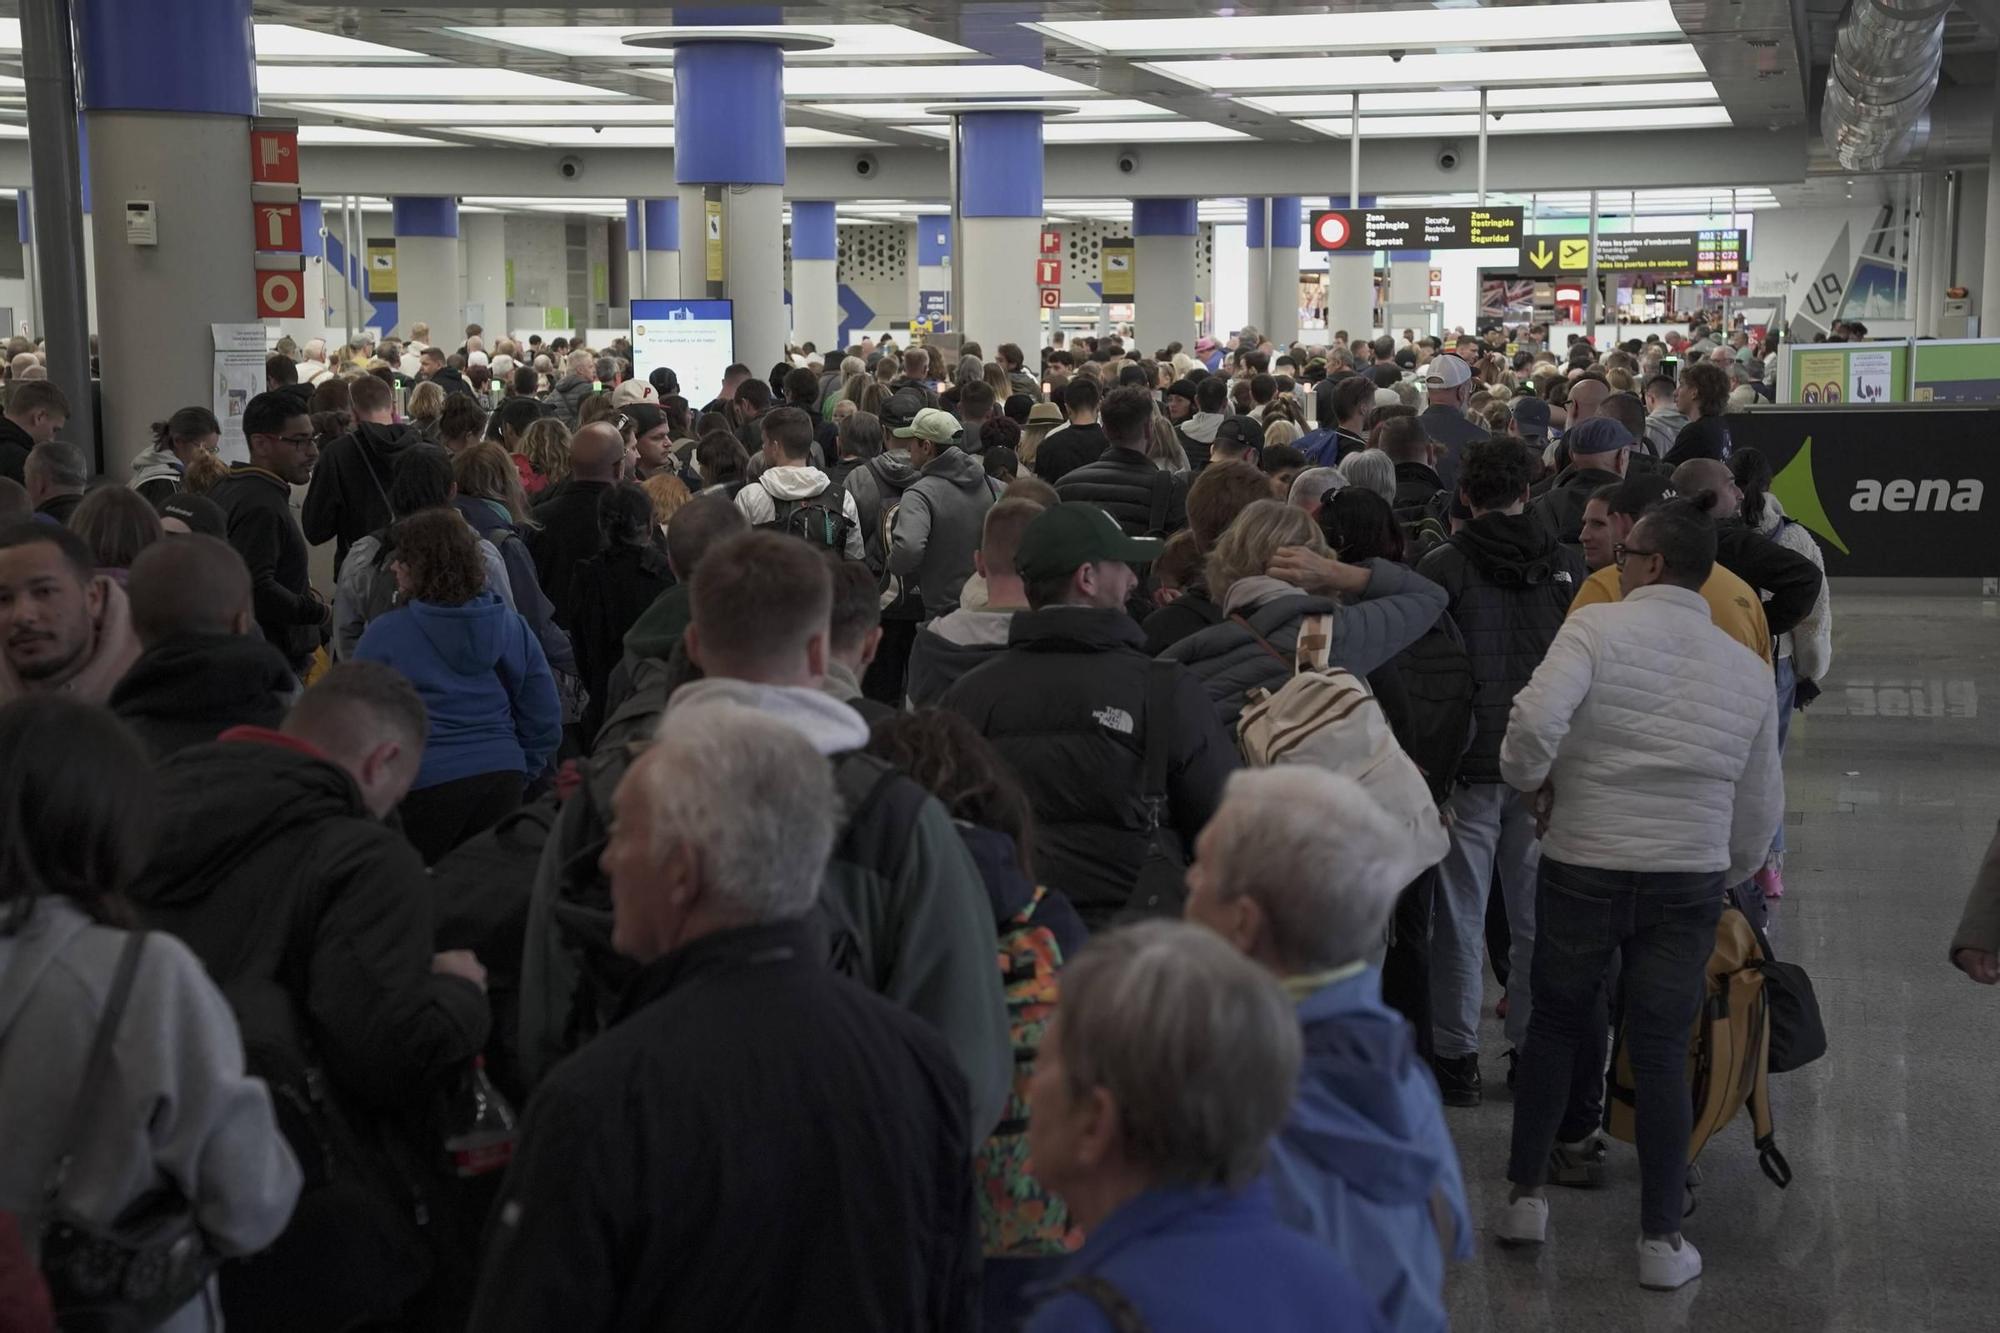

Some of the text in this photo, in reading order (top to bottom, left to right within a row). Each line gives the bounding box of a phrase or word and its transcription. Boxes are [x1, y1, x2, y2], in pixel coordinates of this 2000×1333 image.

[1366, 213, 1385, 221] Zona
[1471, 211, 1490, 219] Zona
[1425, 216, 1449, 225] Security
[1471, 219, 1514, 228] Restringida
[1366, 222, 1409, 231] Restringida
[1425, 225, 1455, 233] Restricted
[1366, 230, 1376, 238] de
[1471, 234, 1509, 243] Seguridad
[1699, 232, 1715, 240] A01
[1624, 239, 1642, 248] portes
[1722, 251, 1738, 260] C73
[1624, 260, 1647, 269] puertas
[1658, 259, 1688, 268] embarque
[643, 387, 652, 399] P
[1850, 478, 1984, 512] aena
